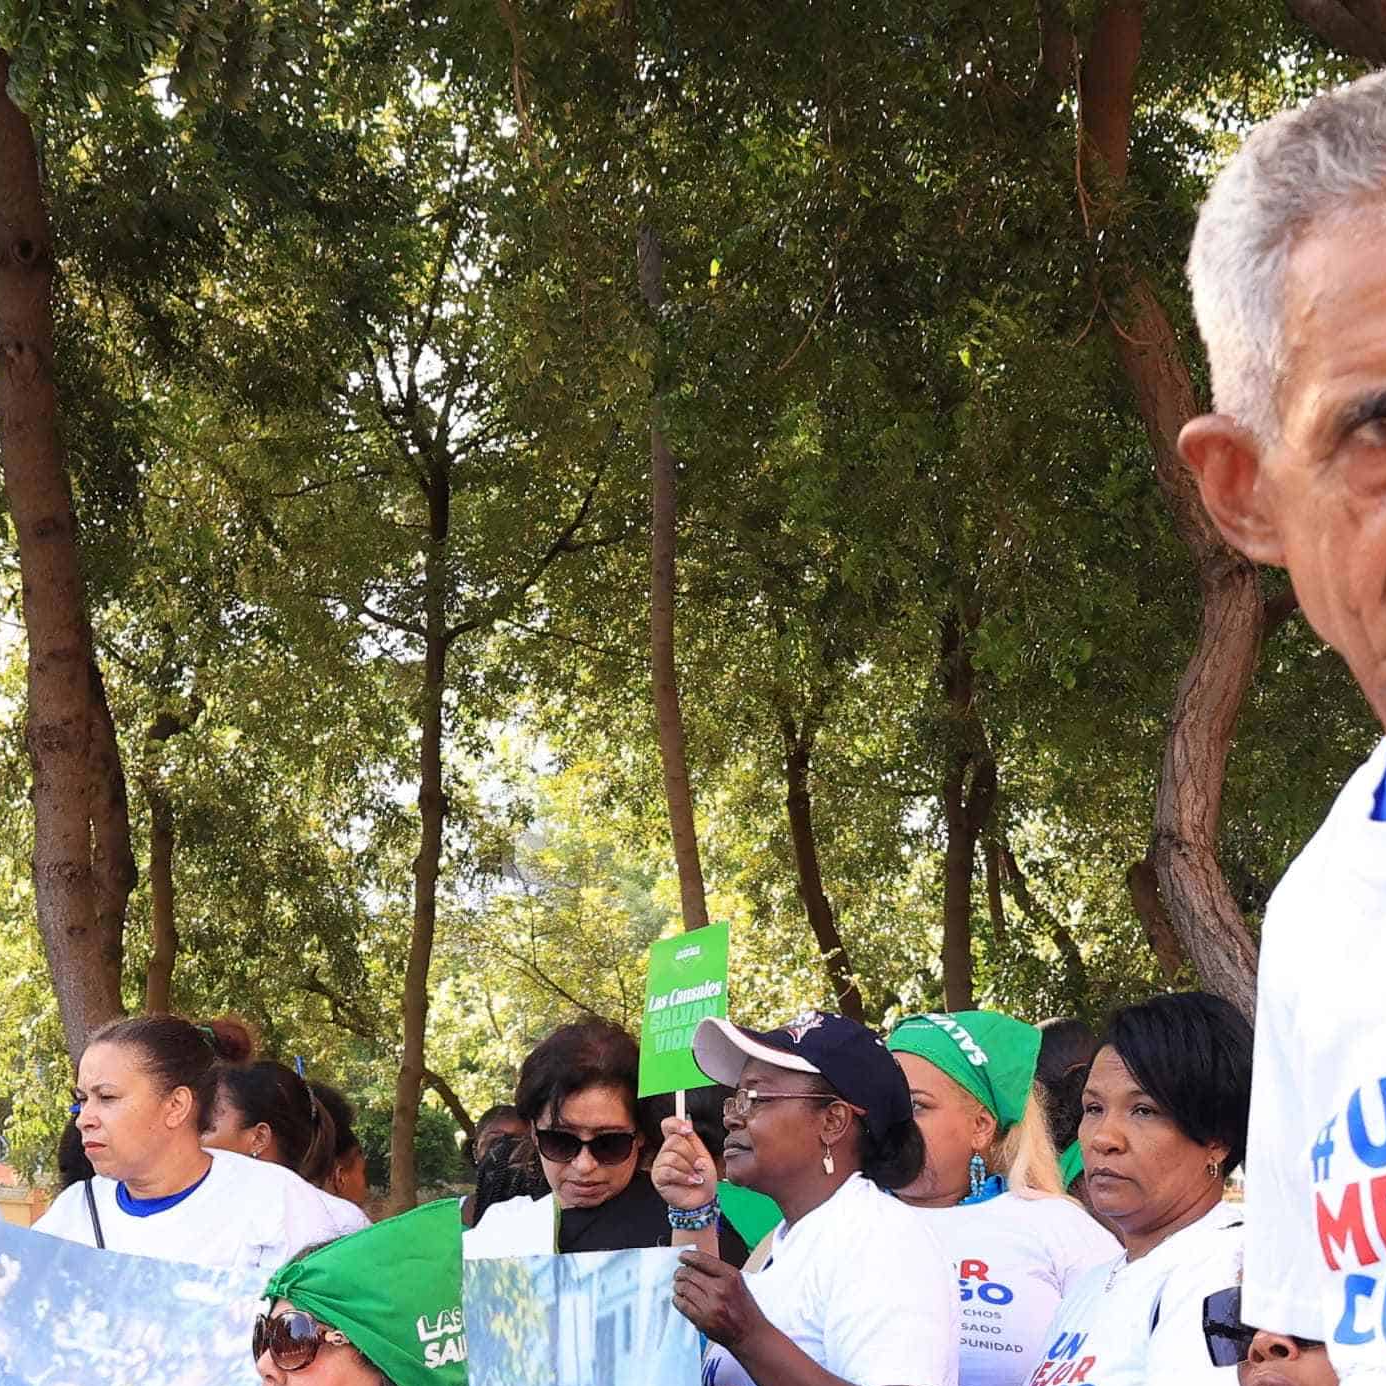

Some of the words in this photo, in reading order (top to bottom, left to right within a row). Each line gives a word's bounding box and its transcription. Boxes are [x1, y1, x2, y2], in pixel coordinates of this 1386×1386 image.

[649, 1001, 719, 1032] SALVAN
[962, 1308, 1003, 1320] CHOS
[960, 1322, 1002, 1335] SADO
